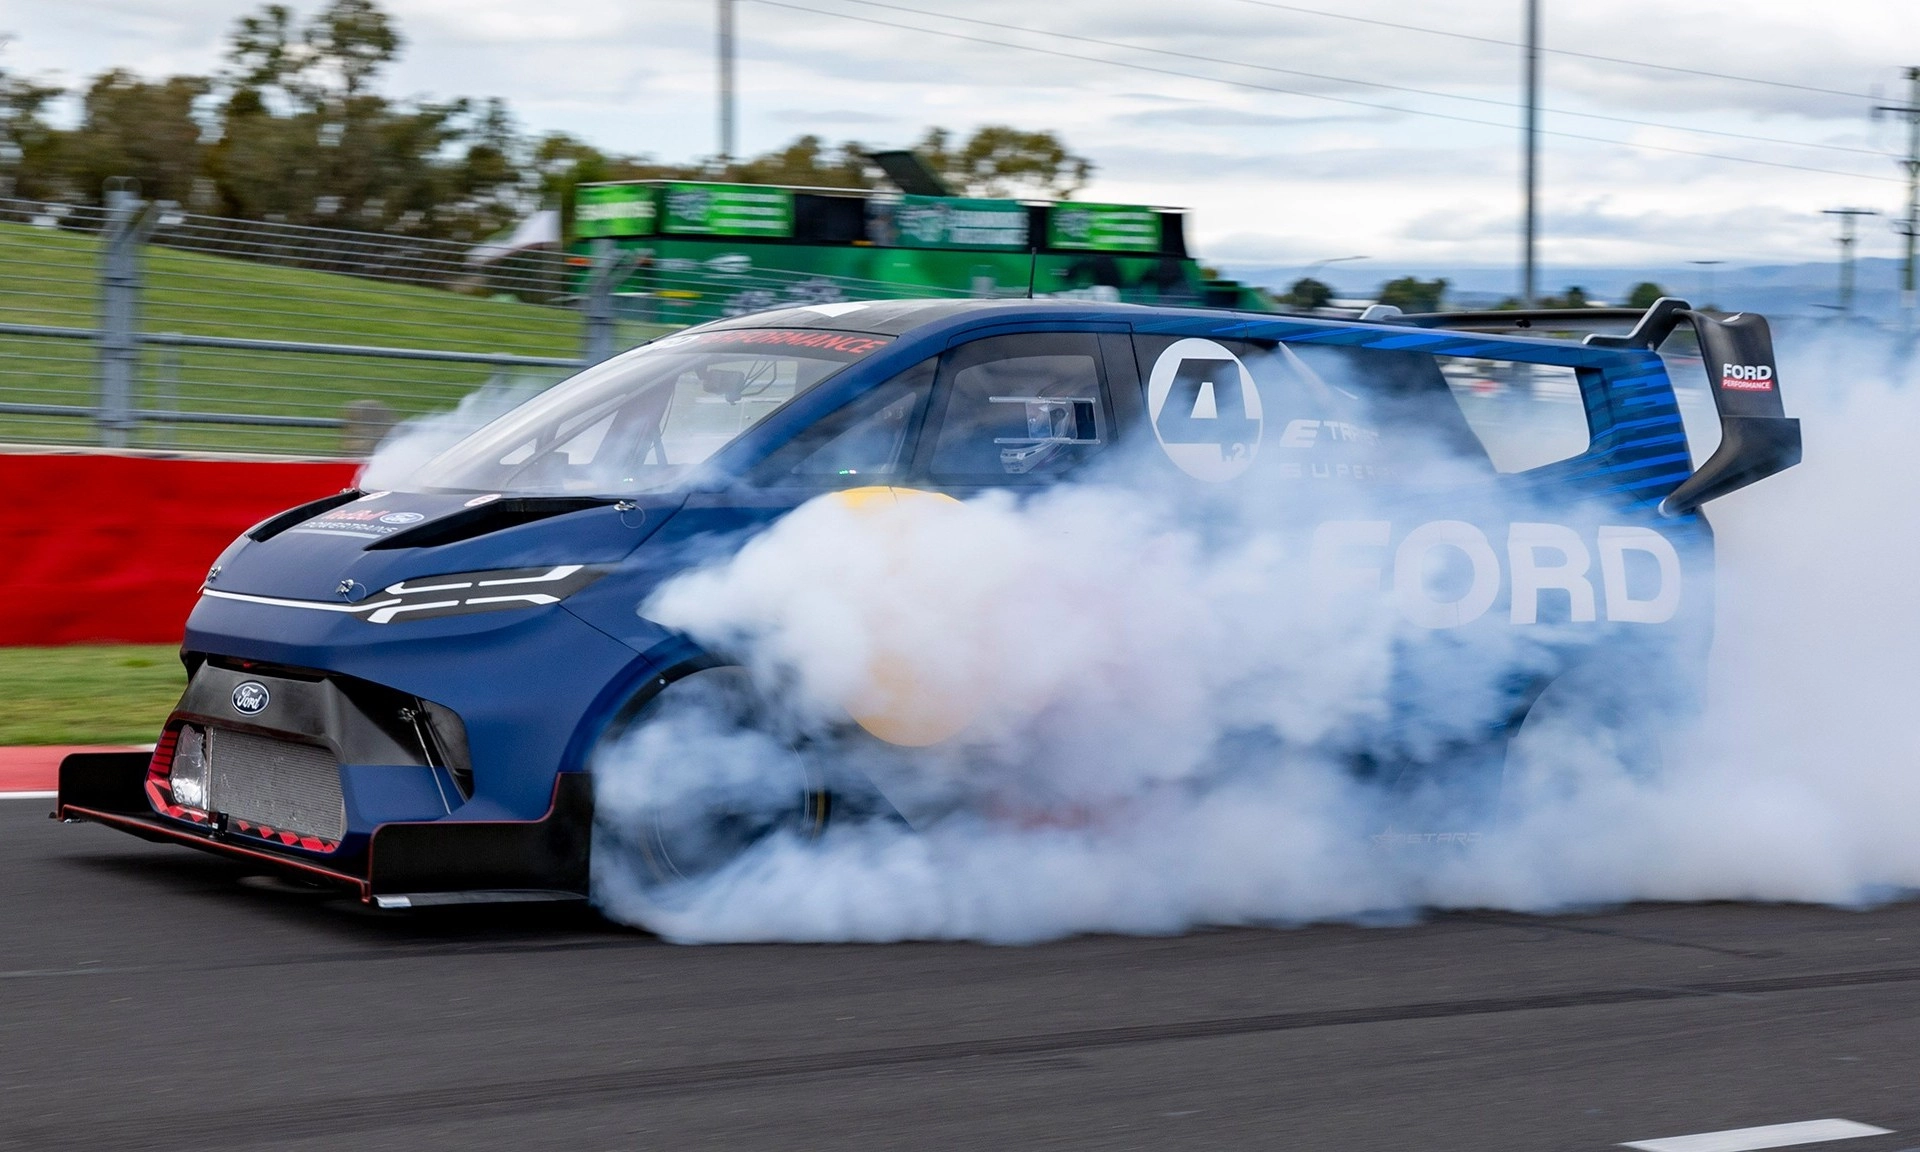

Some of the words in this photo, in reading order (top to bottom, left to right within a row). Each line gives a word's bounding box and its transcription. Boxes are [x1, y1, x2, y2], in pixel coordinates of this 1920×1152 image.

[1723, 363, 1772, 380] FORD
[1723, 379, 1771, 389] PERFORMANCE
[1310, 520, 1681, 629] FORD
[235, 685, 264, 710] Ford
